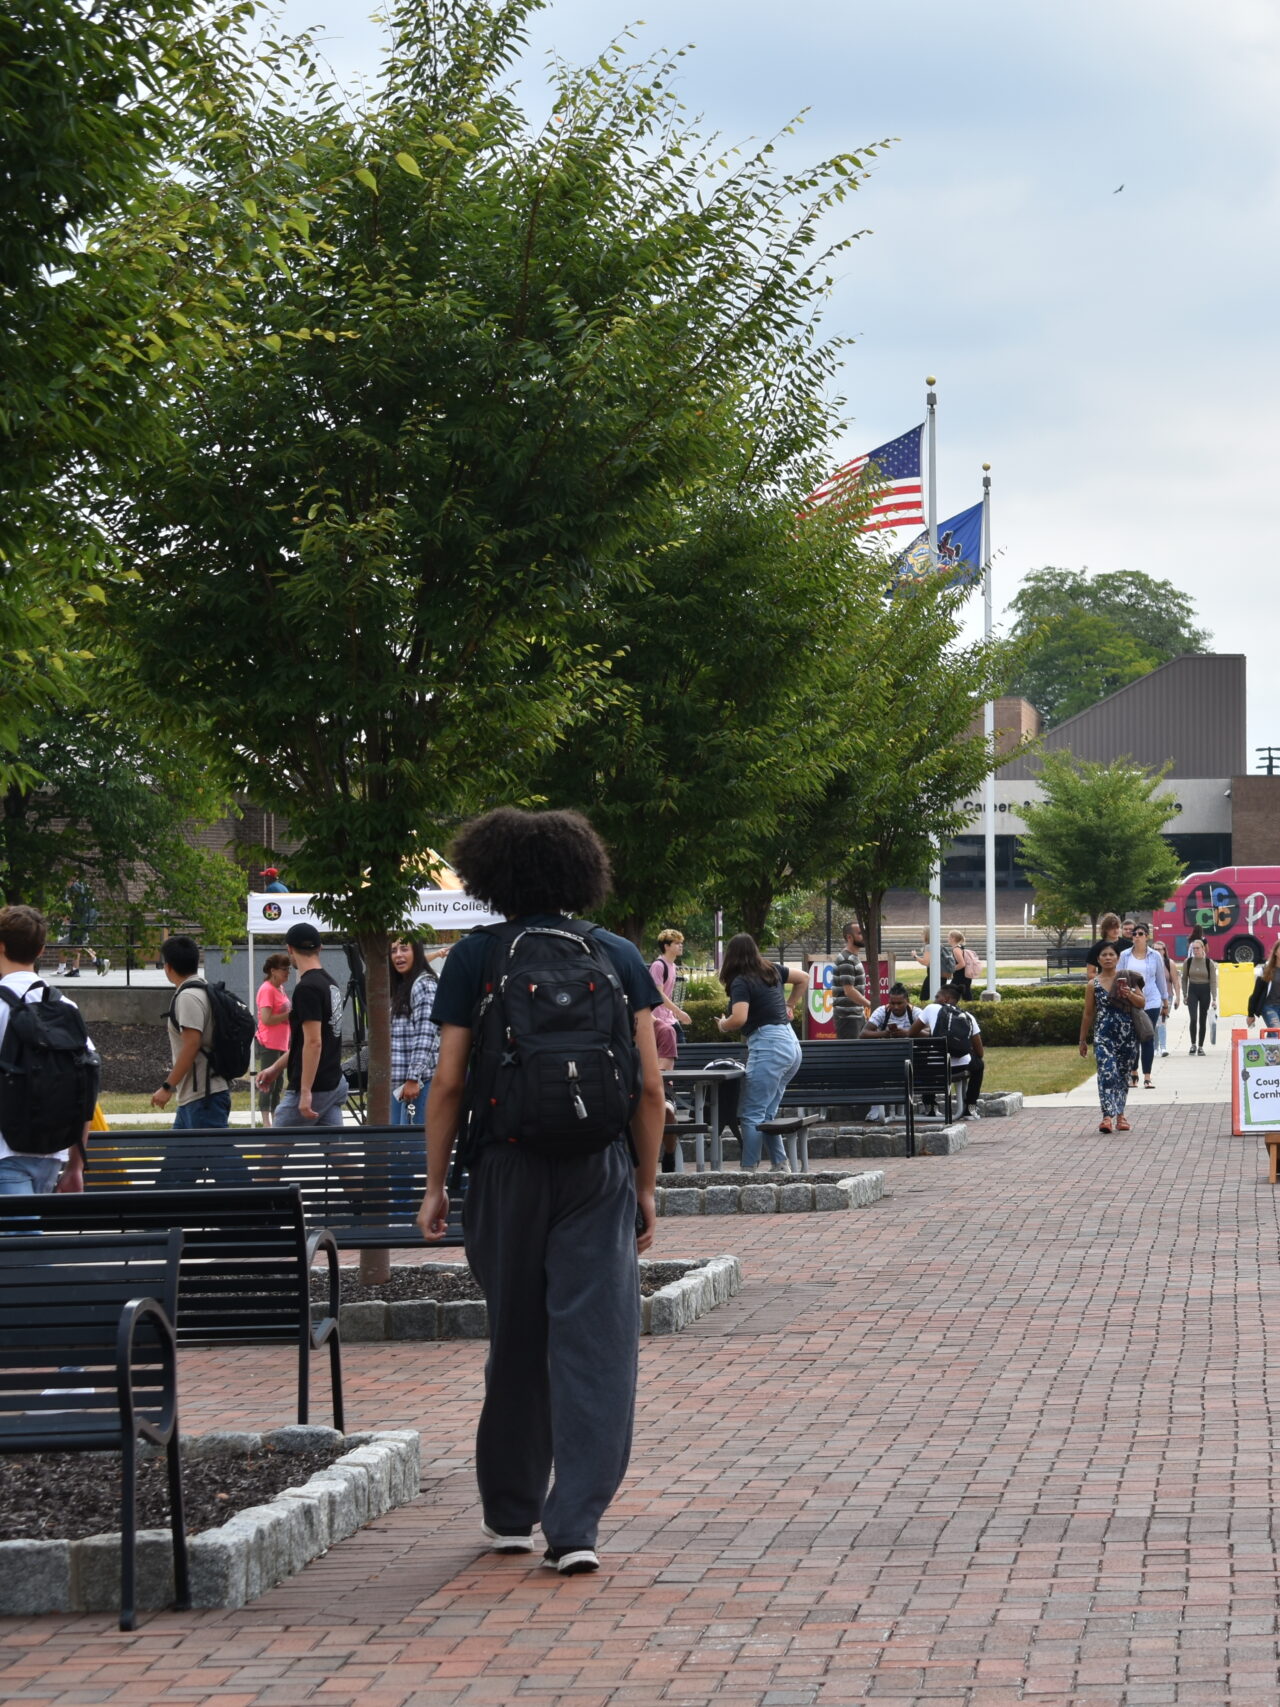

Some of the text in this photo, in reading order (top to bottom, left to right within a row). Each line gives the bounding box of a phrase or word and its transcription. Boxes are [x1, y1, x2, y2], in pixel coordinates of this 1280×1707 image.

[963, 801, 1012, 813] Carer
[410, 902, 448, 914] munity
[453, 901, 490, 913] Colleg
